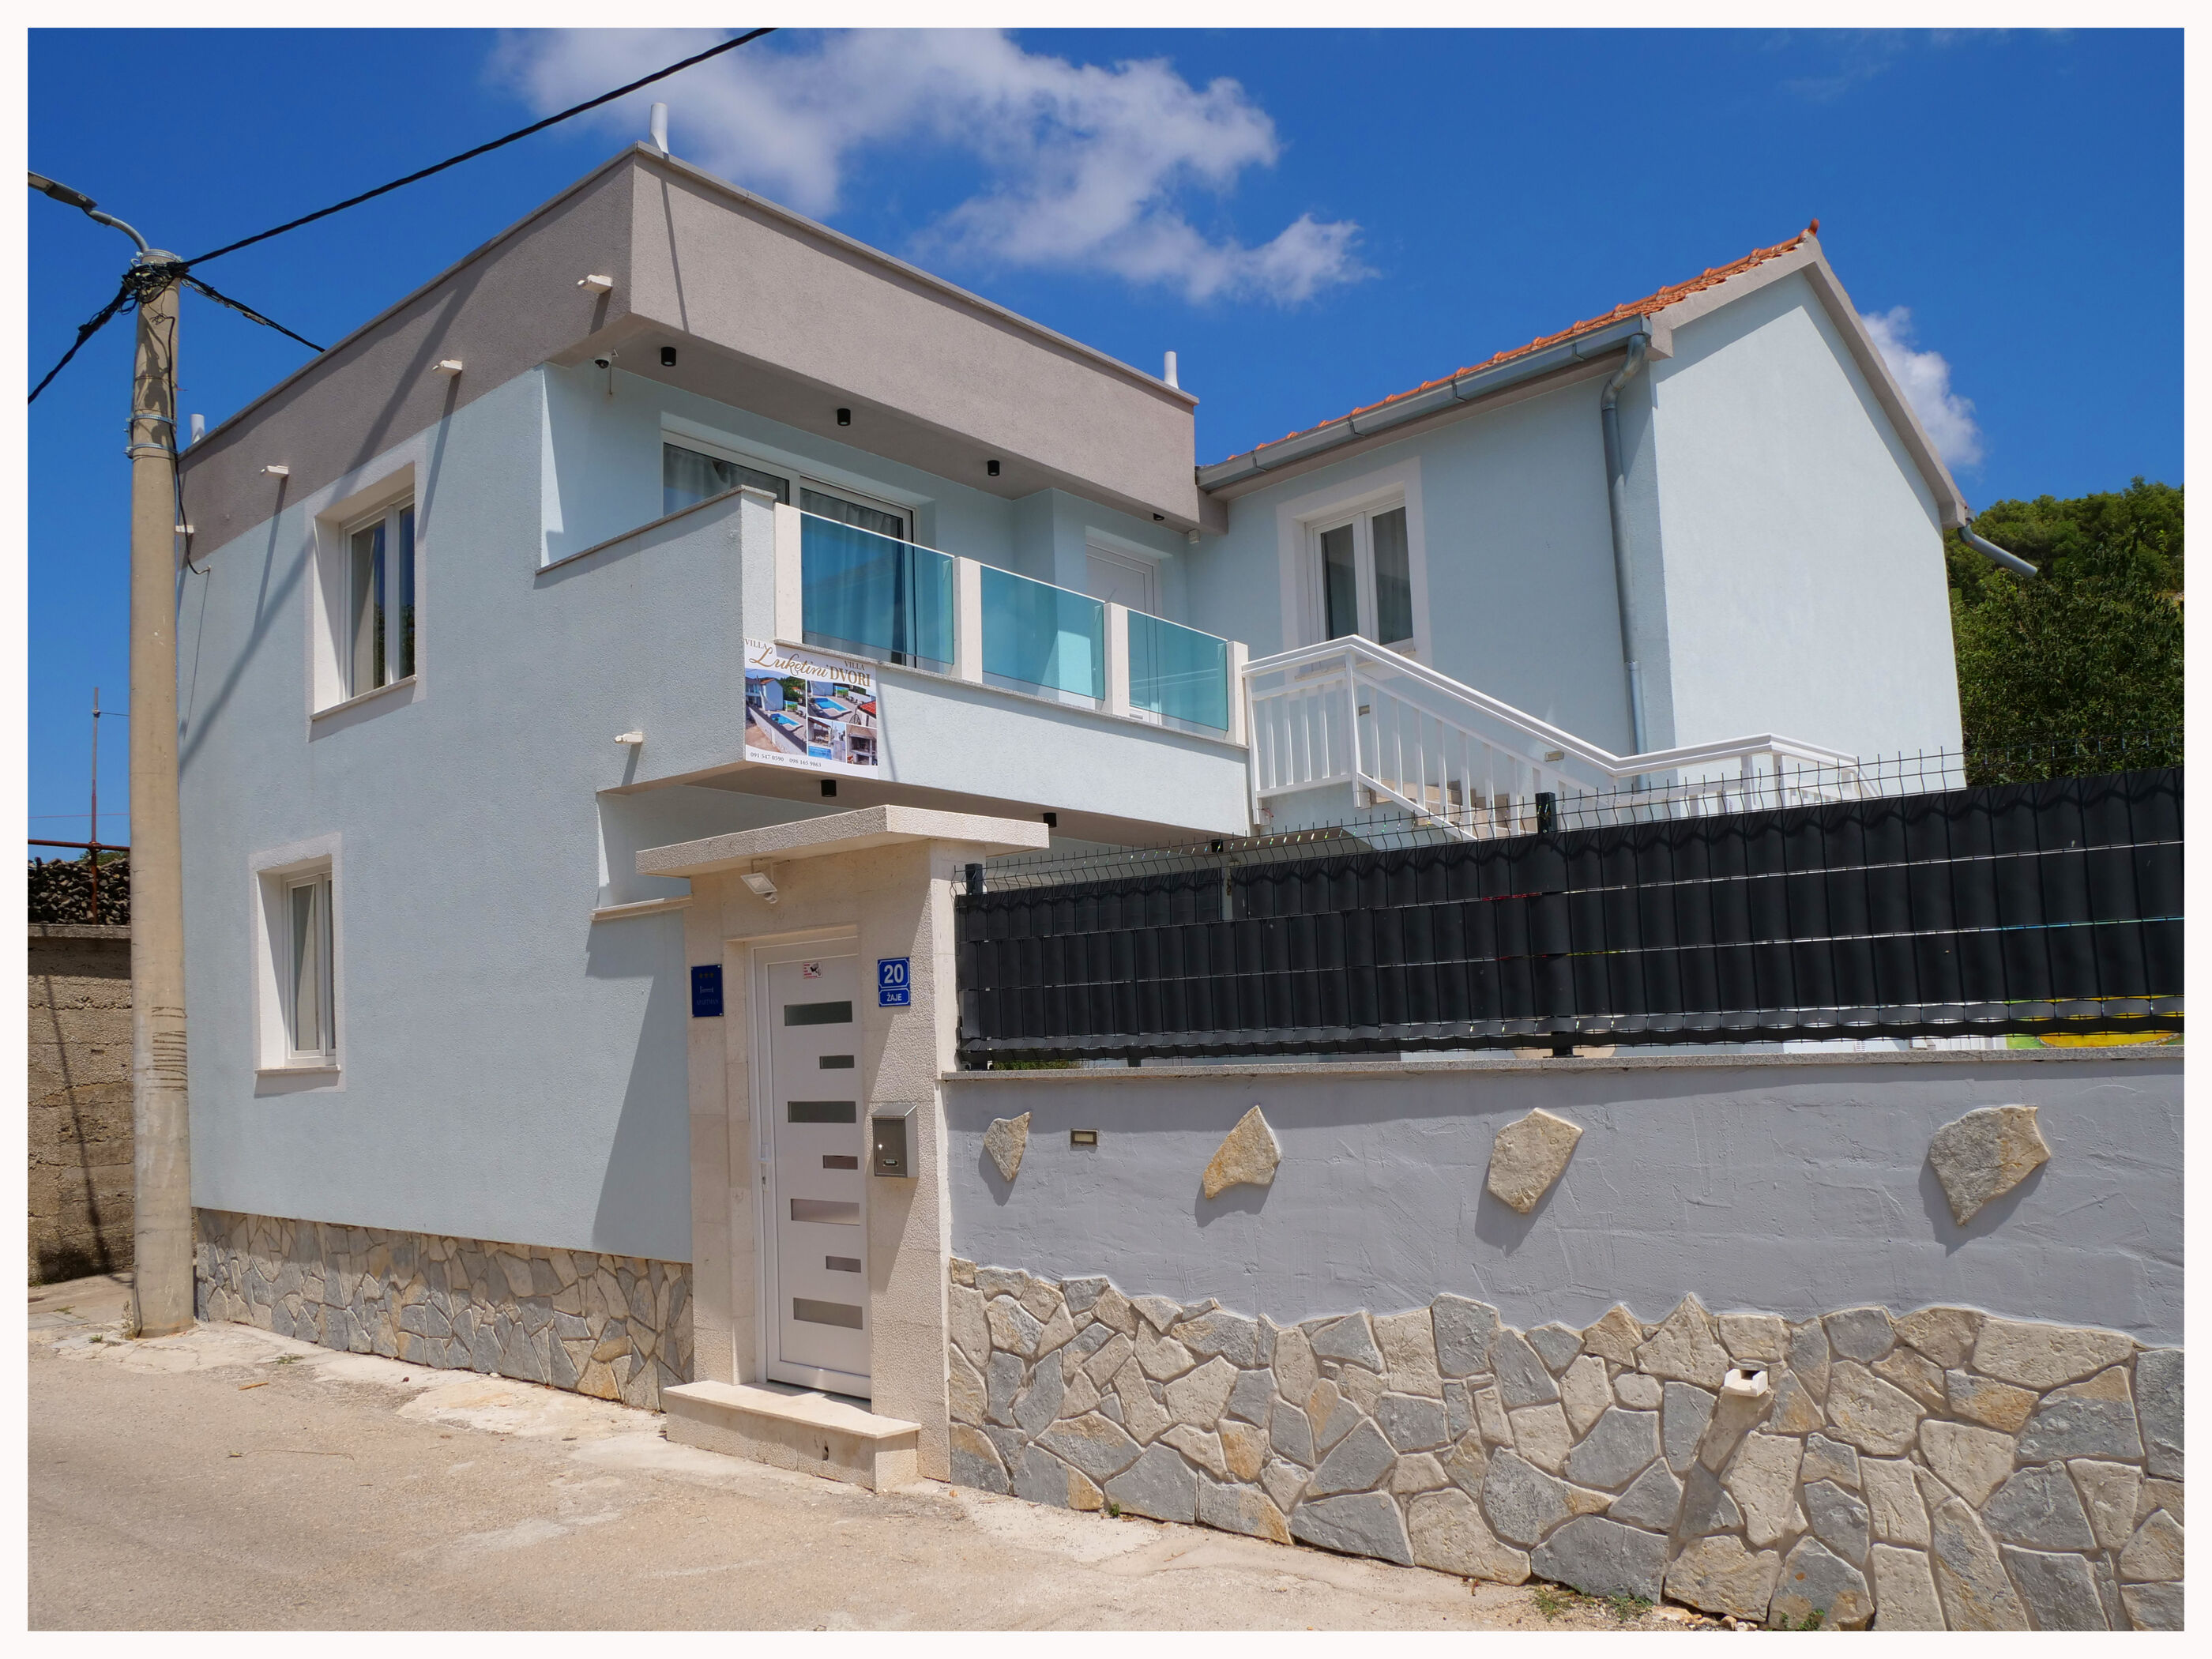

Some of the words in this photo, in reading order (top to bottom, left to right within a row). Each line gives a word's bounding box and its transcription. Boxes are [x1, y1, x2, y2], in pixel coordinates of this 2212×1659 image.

[744, 638, 767, 649] VILLA
[750, 647, 829, 676] Luketini
[830, 666, 871, 687] DVORI
[845, 660, 865, 671] VILLA
[884, 964, 904, 984] 20
[886, 992, 902, 1002] ŽAJE
